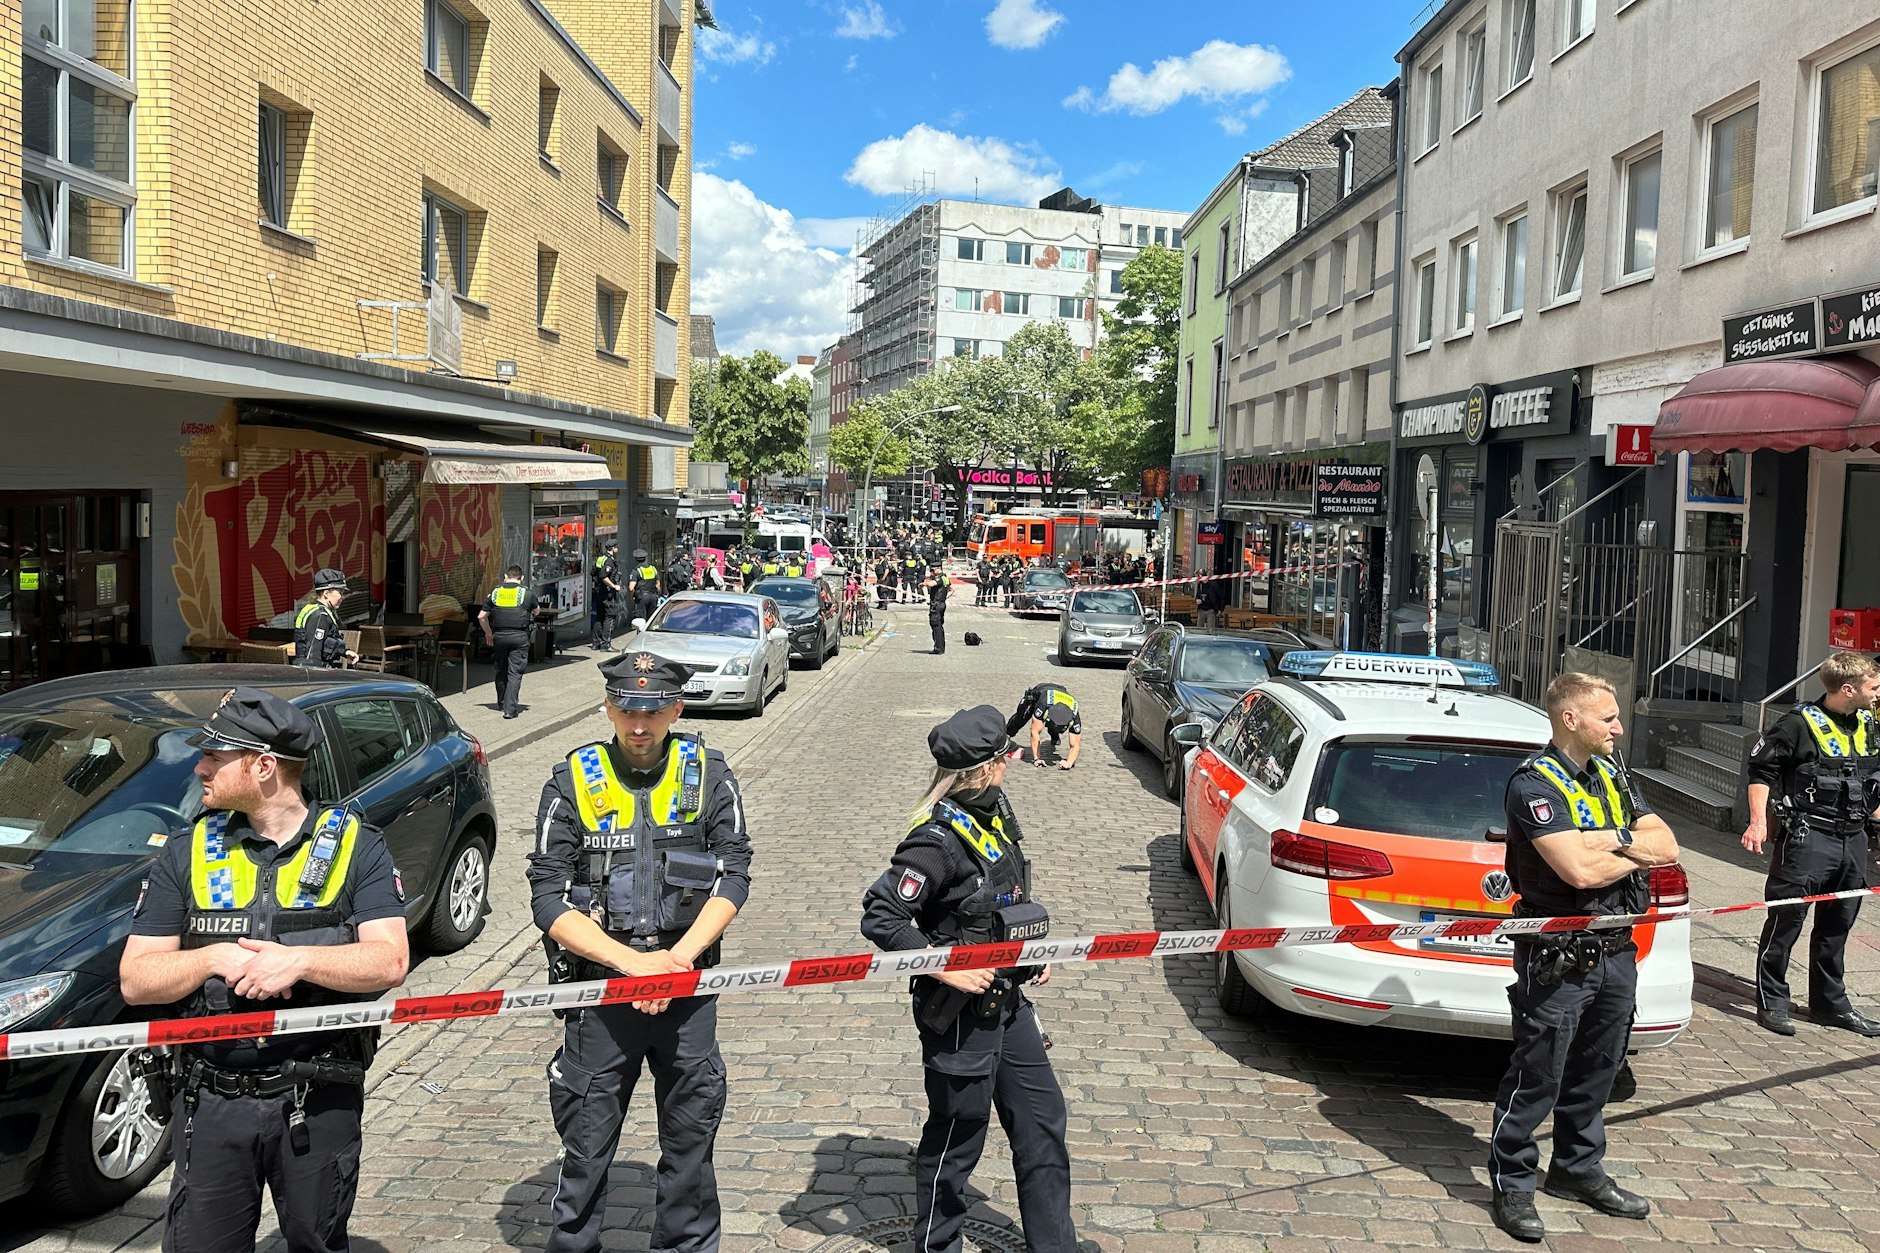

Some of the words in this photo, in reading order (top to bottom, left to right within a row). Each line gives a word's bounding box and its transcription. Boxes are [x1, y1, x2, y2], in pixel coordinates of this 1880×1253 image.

[1742, 311, 1795, 335] GETRÄNKE
[1490, 386, 1553, 429] COFFEE
[1621, 451, 1650, 462] Coca-Cola
[1228, 463, 1278, 491] RESTAURANT
[1279, 462, 1286, 490] &
[1319, 466, 1382, 476] RESTAURANT
[1323, 505, 1374, 513] SPEZIALITÄTEN
[1204, 524, 1218, 533] sky
[1334, 657, 1453, 677] FEUERWEHR
[666, 828, 682, 837] Tayé
[583, 834, 635, 849] POLIZEI
[190, 916, 248, 933] POLIZEI
[1010, 921, 1048, 940] POLIZEI
